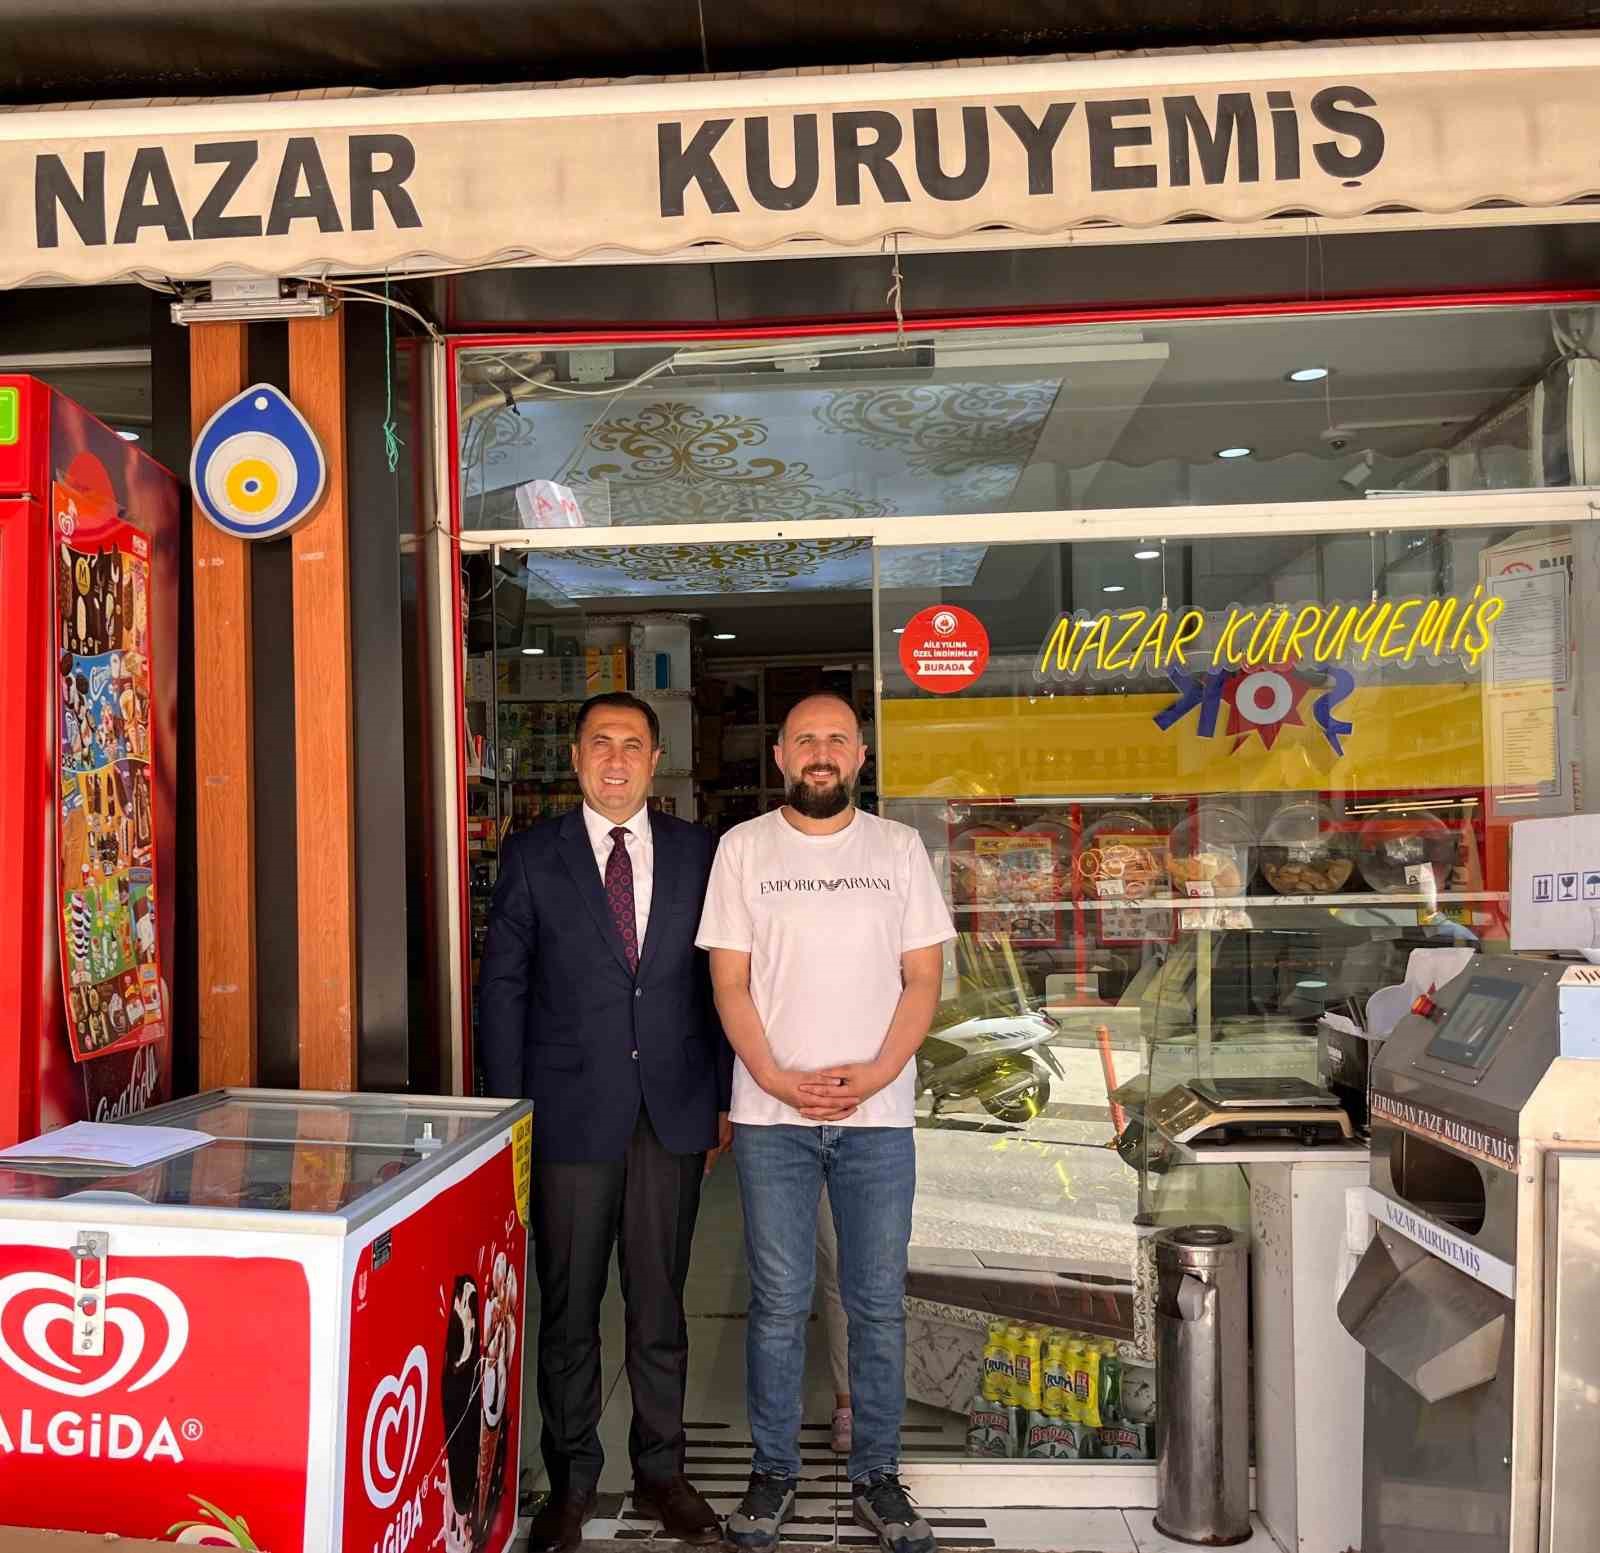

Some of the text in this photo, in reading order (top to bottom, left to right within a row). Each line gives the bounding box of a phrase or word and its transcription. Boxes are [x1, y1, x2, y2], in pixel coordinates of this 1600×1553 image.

[34, 133, 423, 249] NAZAR
[913, 648, 932, 657] ÖZEL
[1040, 610, 1205, 673] NAZAR
[1212, 584, 1504, 667] KURUYEMİŞ
[924, 663, 965, 671] BURADA
[760, 877, 891, 895] EMPORIO ARMANI
[1374, 1093, 1515, 1169] FIRINDAN TAZE KURUYEMİŞ
[1386, 1200, 1480, 1276] NAZAR KURUYEMİŞ
